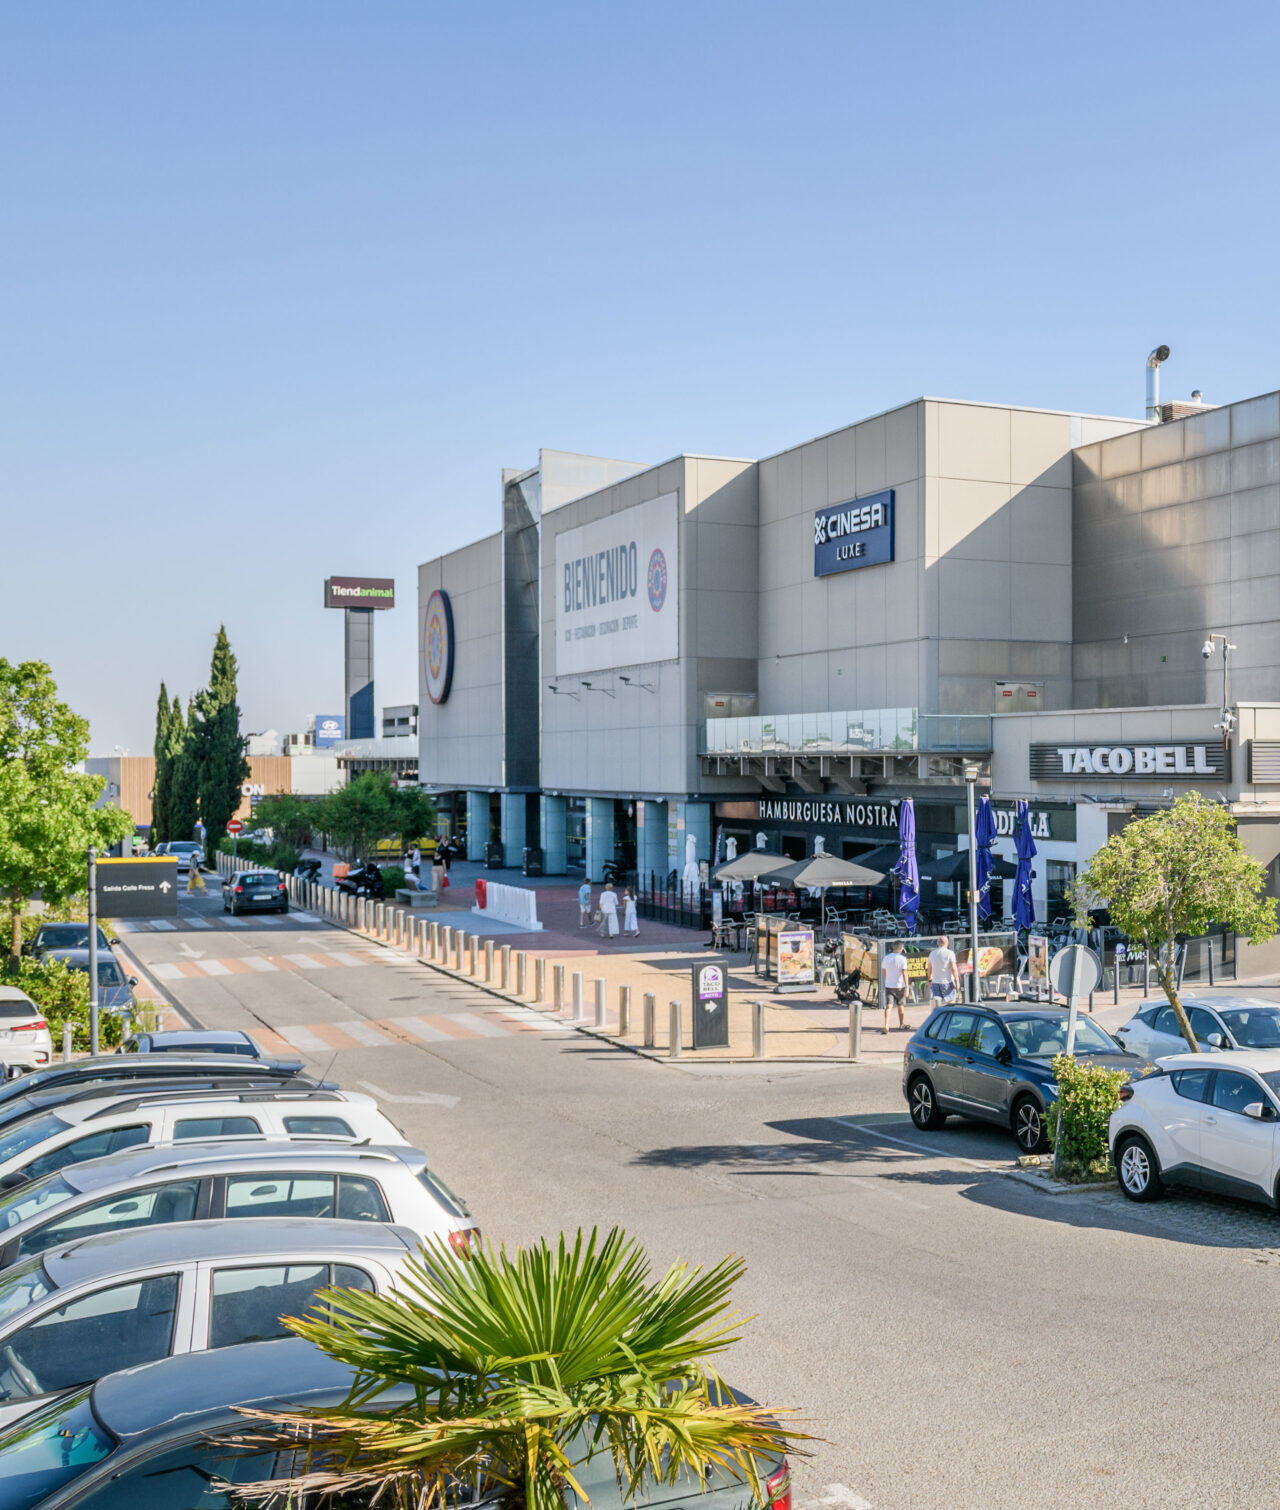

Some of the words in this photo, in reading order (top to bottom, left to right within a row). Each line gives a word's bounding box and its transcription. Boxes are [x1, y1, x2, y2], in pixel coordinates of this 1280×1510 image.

[827, 502, 883, 538] CINESA
[836, 542, 861, 560] LUXE
[564, 541, 637, 613] BIENVENIDO
[331, 585, 394, 598] Tiendanimal
[1057, 747, 1134, 775] TACO
[1135, 746, 1217, 774] BELL
[760, 800, 841, 823] HAMBURGUESA
[846, 804, 898, 827] NOSTRA
